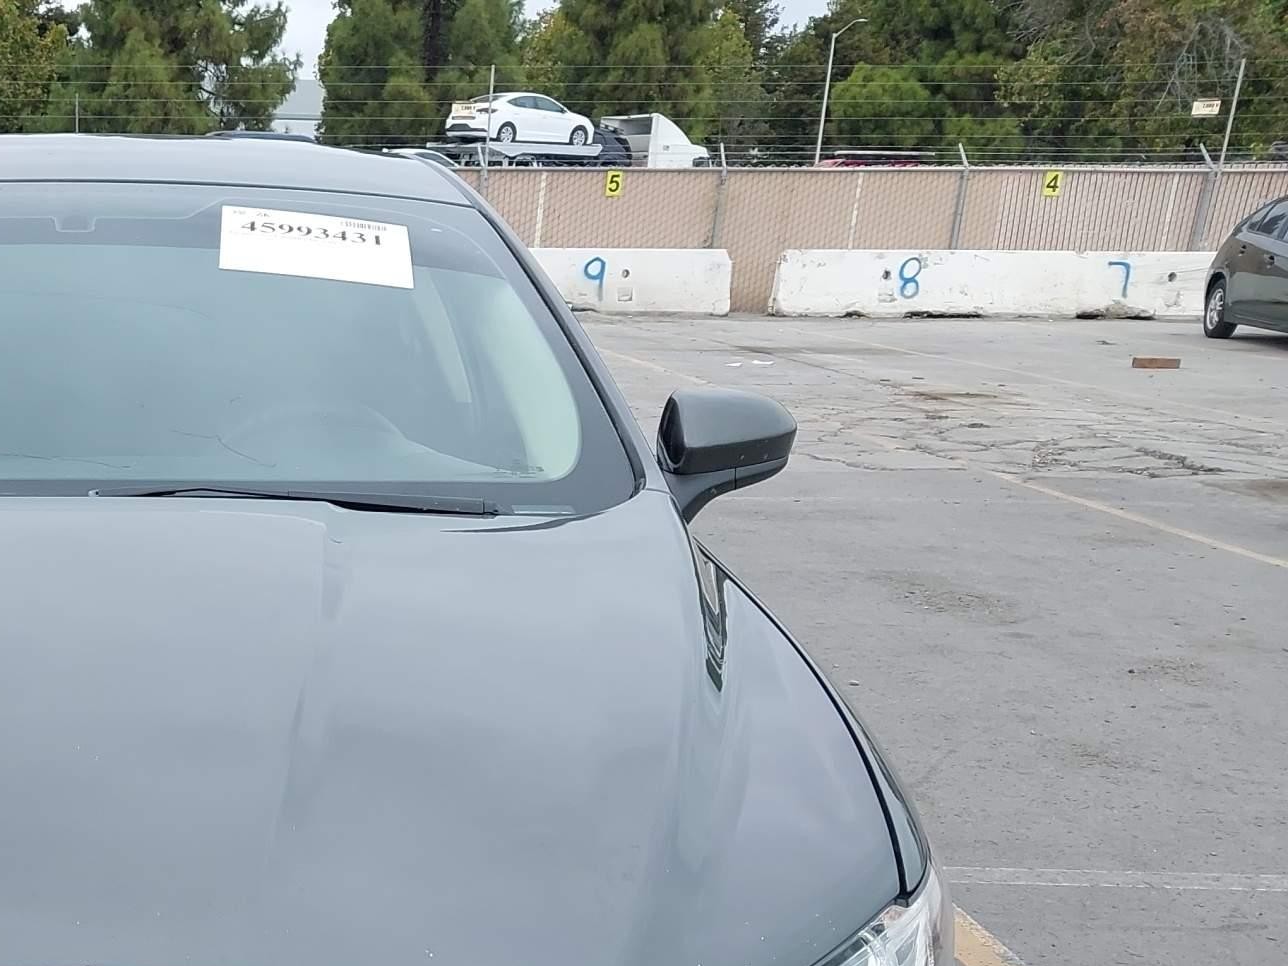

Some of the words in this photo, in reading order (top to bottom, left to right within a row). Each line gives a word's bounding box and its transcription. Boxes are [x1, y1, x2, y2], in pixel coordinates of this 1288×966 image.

[608, 174, 621, 192] 5
[1045, 174, 1059, 192] 4
[241, 221, 381, 245] 45993431
[584, 256, 606, 301] 9
[899, 257, 922, 299] 8
[1108, 261, 1130, 299] 7
